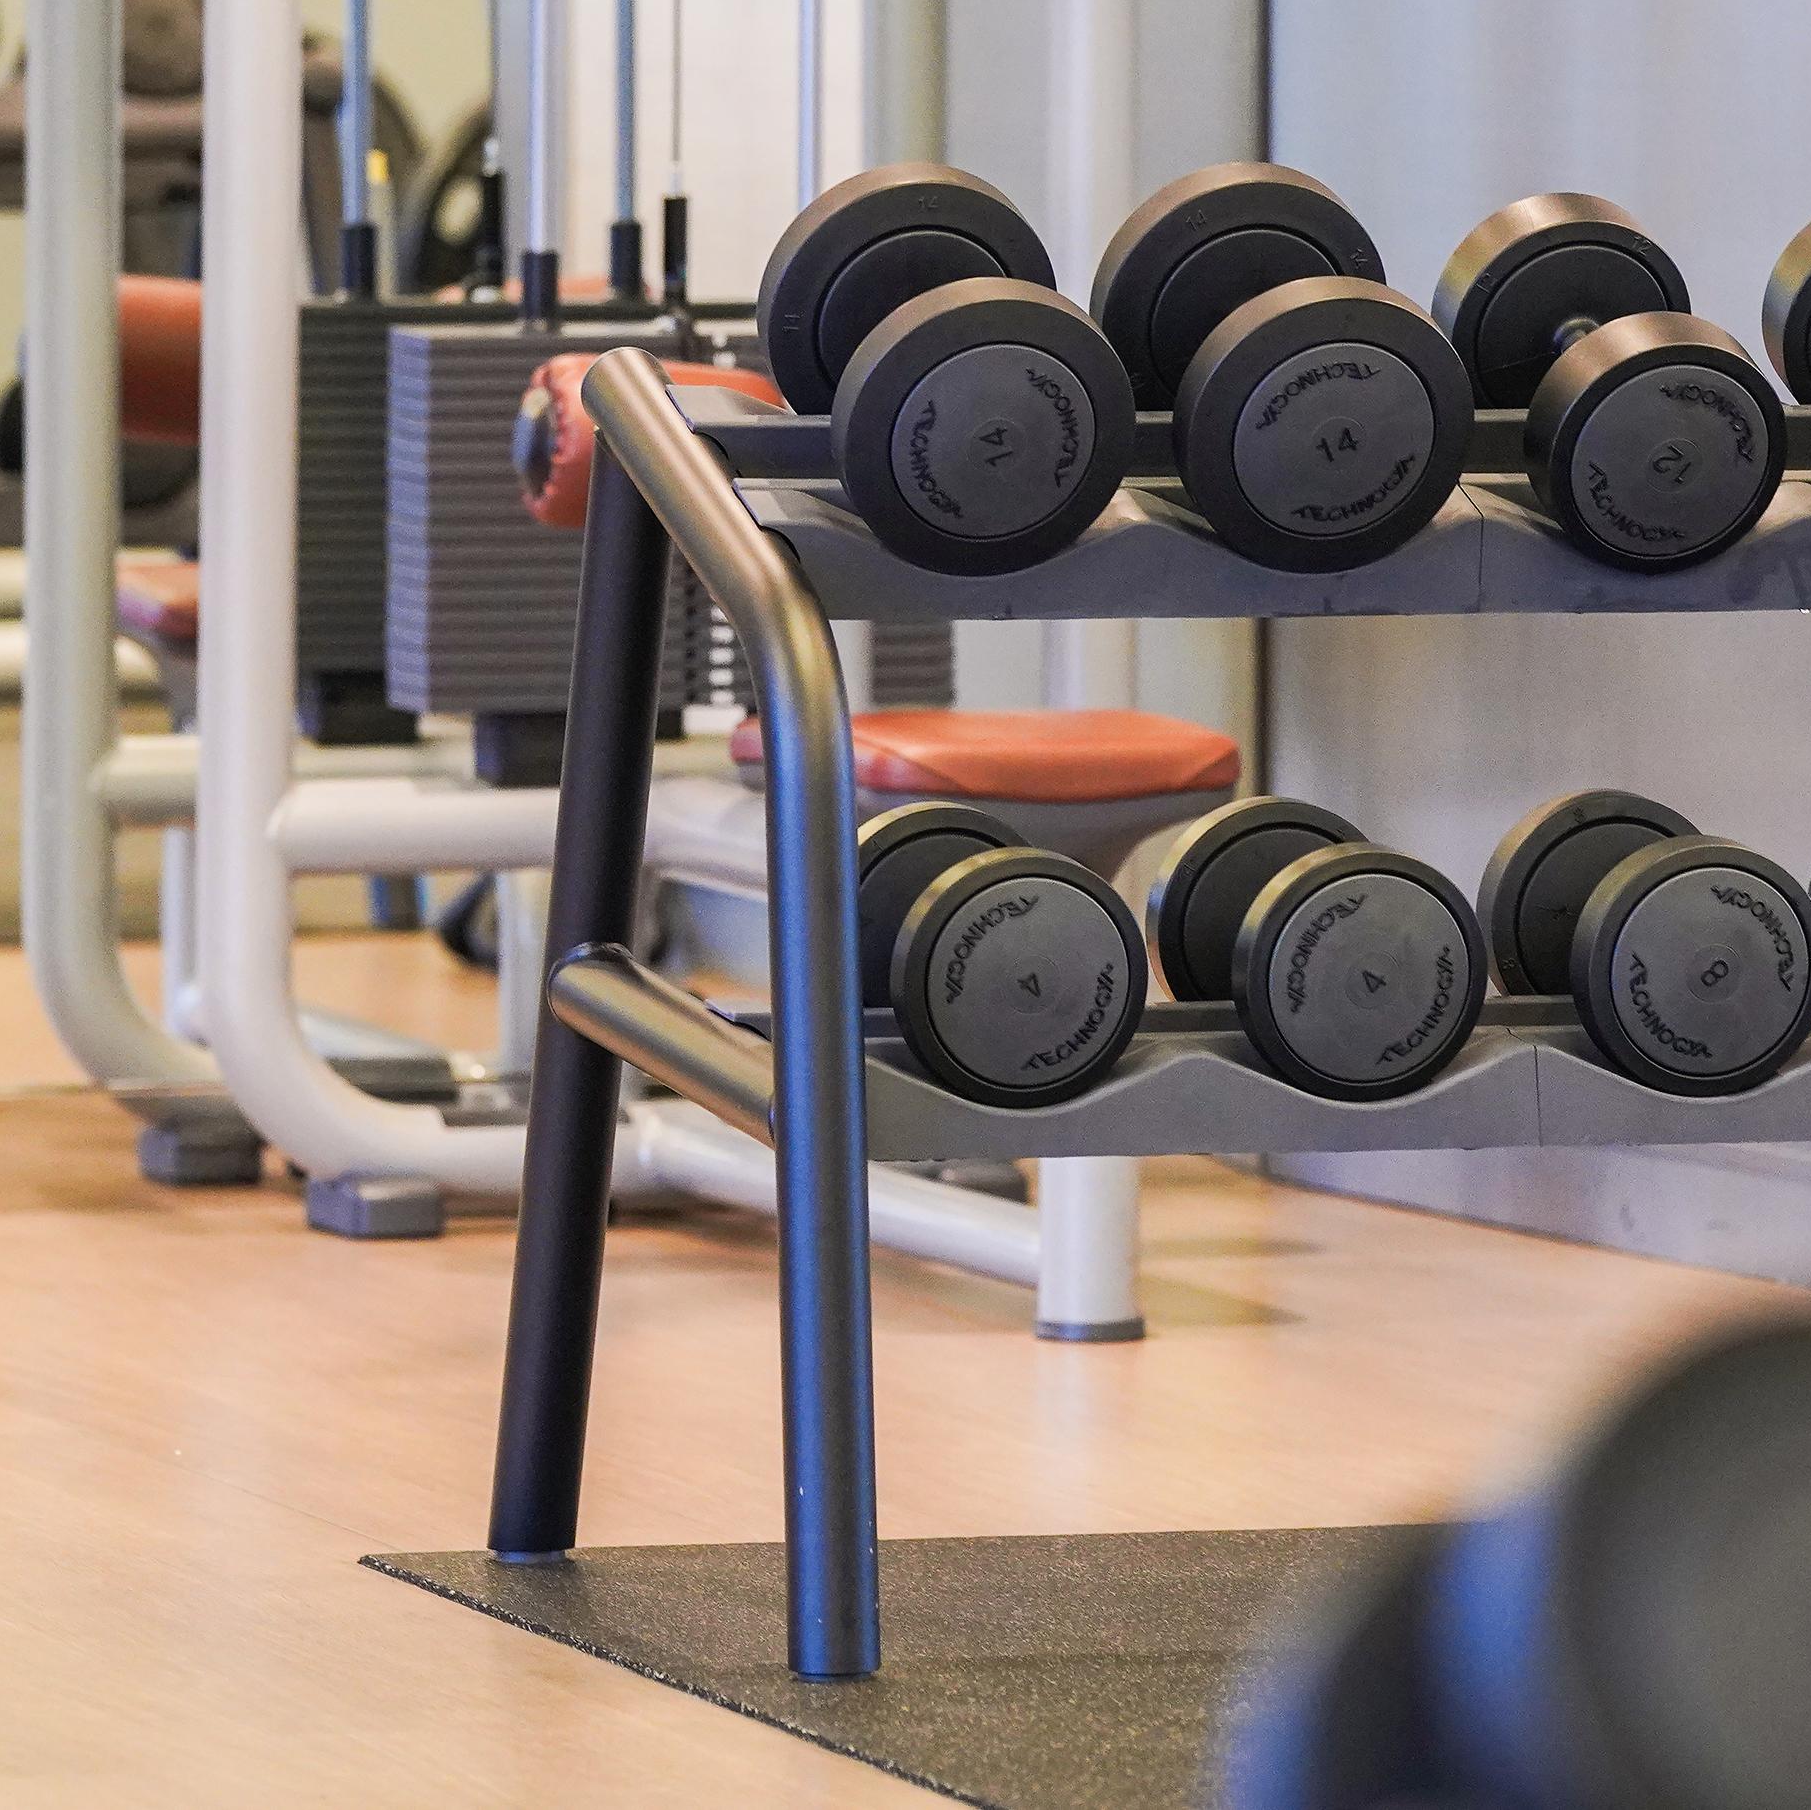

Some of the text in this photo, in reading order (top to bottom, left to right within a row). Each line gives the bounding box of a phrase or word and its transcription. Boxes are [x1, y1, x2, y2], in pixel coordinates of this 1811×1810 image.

[977, 426, 1015, 468] 14
[1315, 426, 1360, 464] 14
[1652, 443, 1692, 485] 12
[1016, 971, 1041, 999] 4
[1361, 969, 1387, 994] 4
[1699, 958, 1730, 988] 8
